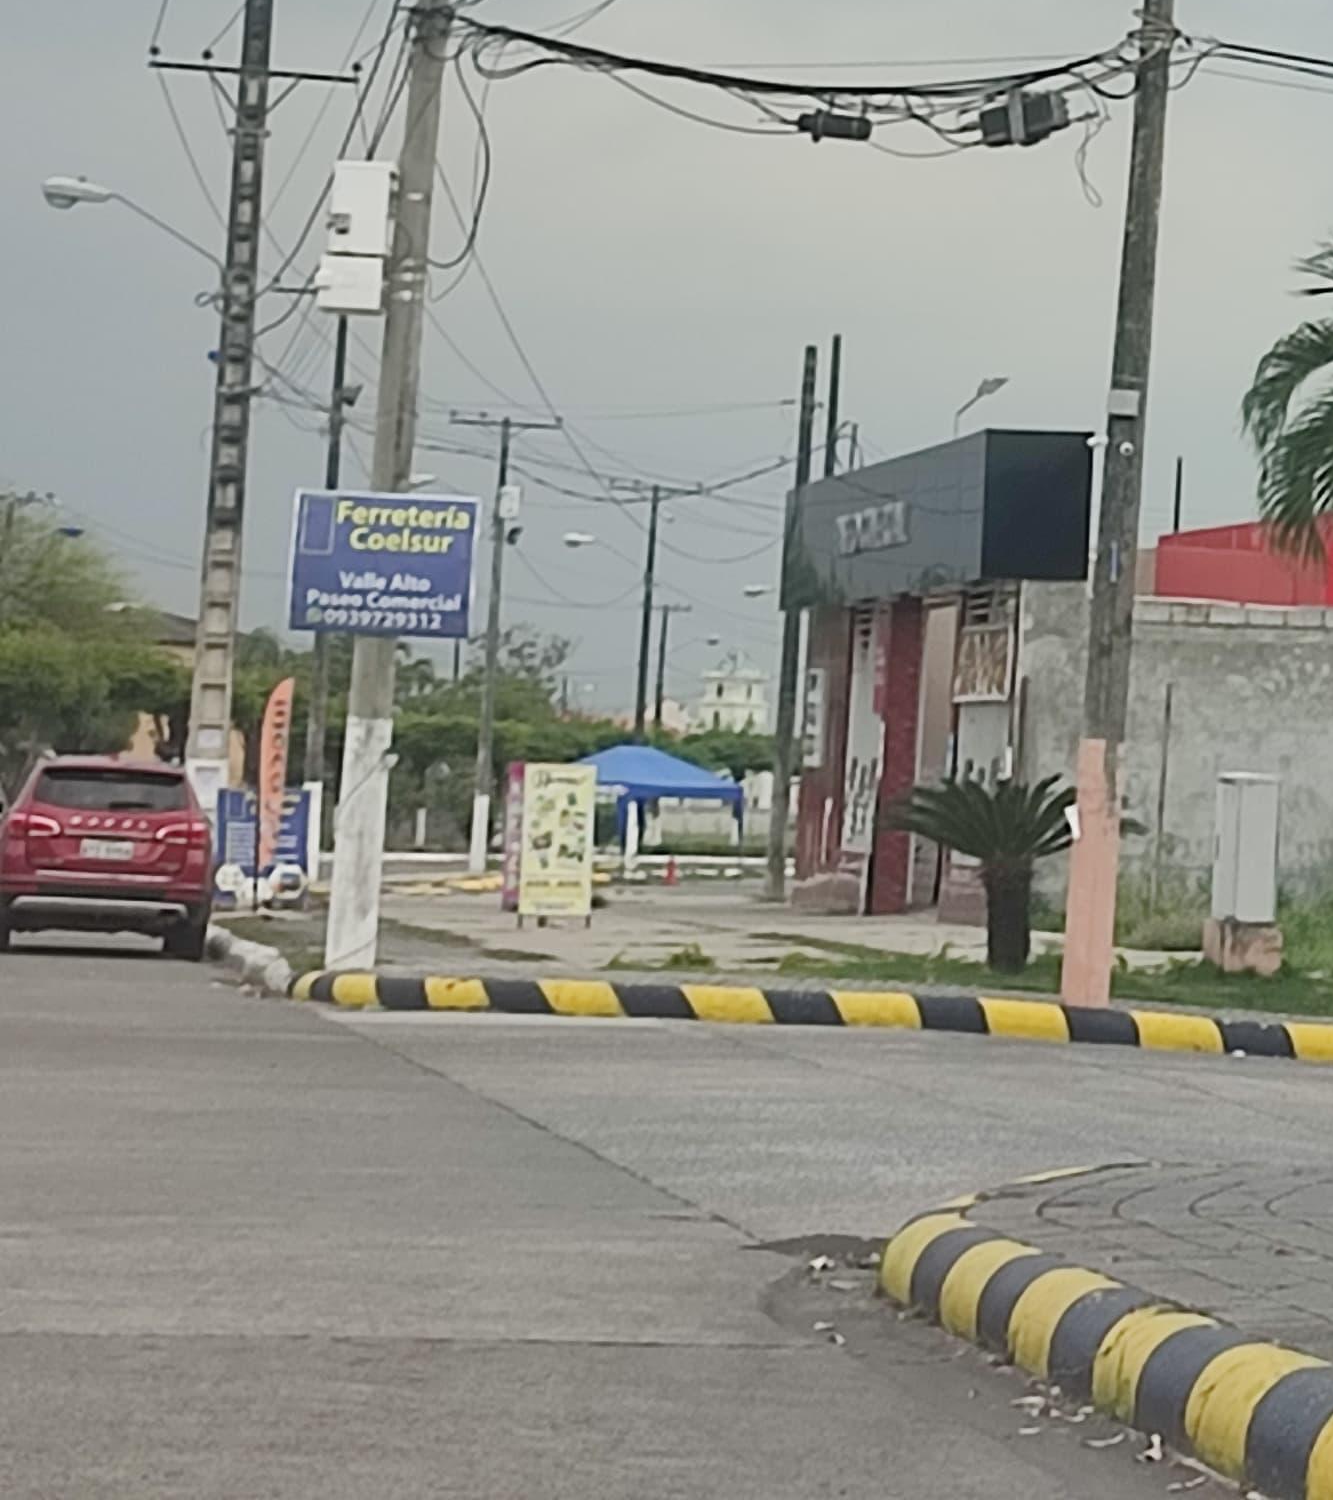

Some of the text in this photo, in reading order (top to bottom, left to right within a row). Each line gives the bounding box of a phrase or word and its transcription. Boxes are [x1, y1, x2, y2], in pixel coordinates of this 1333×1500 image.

[349, 527, 454, 553] Coelsur
[339, 571, 432, 593] Valle Alto
[306, 588, 462, 612] Paseo Comercial
[323, 608, 442, 630] 0939729312
